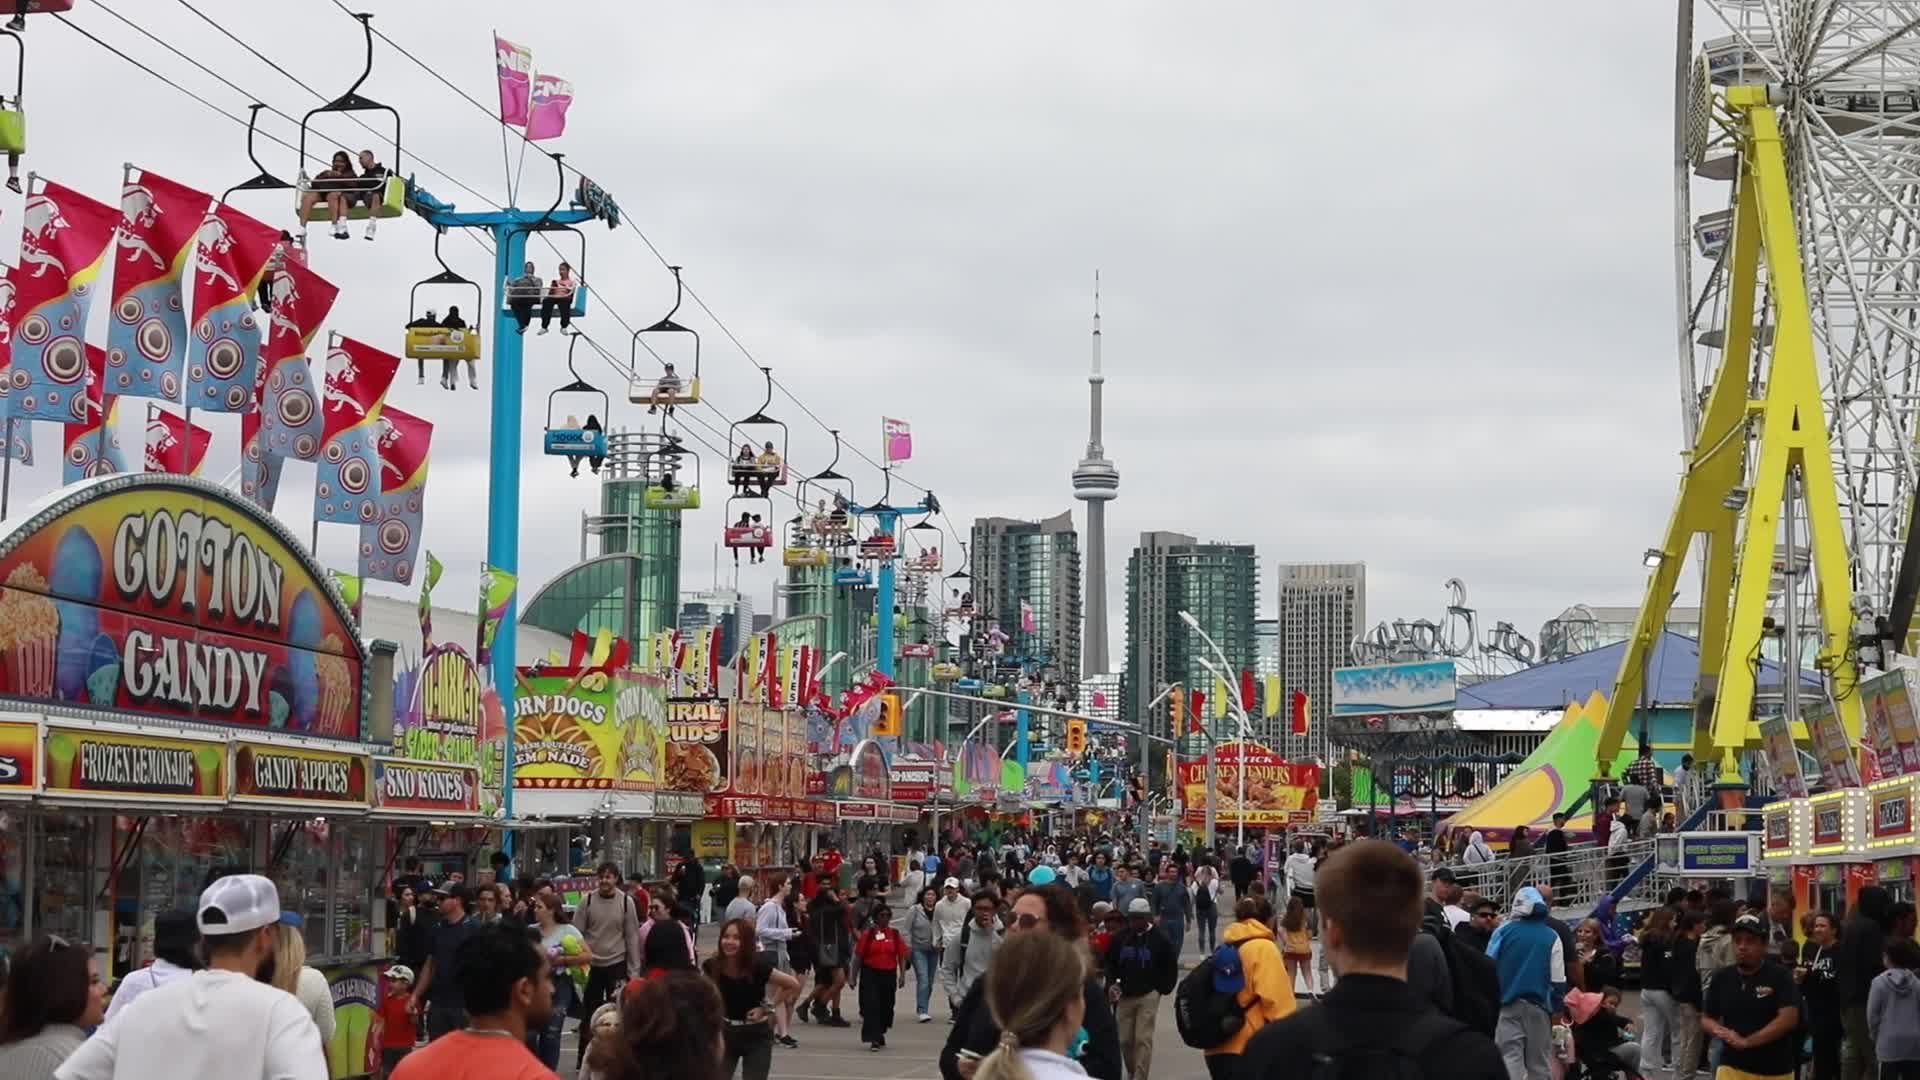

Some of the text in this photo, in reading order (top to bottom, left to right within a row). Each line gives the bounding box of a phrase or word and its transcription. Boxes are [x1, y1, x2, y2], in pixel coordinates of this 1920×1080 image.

[498, 49, 532, 73] NE
[114, 510, 283, 627] COTTON
[124, 630, 267, 713] CANDY
[789, 649, 799, 702] FRIES
[513, 695, 606, 723] RN DOGS
[667, 703, 720, 721] IRAL
[514, 741, 540, 753] RESH
[667, 725, 719, 742] UDS
[80, 741, 195, 787] FROZEN LEMONADE
[255, 753, 349, 793] CANDY APPLES
[1190, 765, 1290, 784] CHKEN ENDERS
[387, 768, 463, 801] SNO KONES
